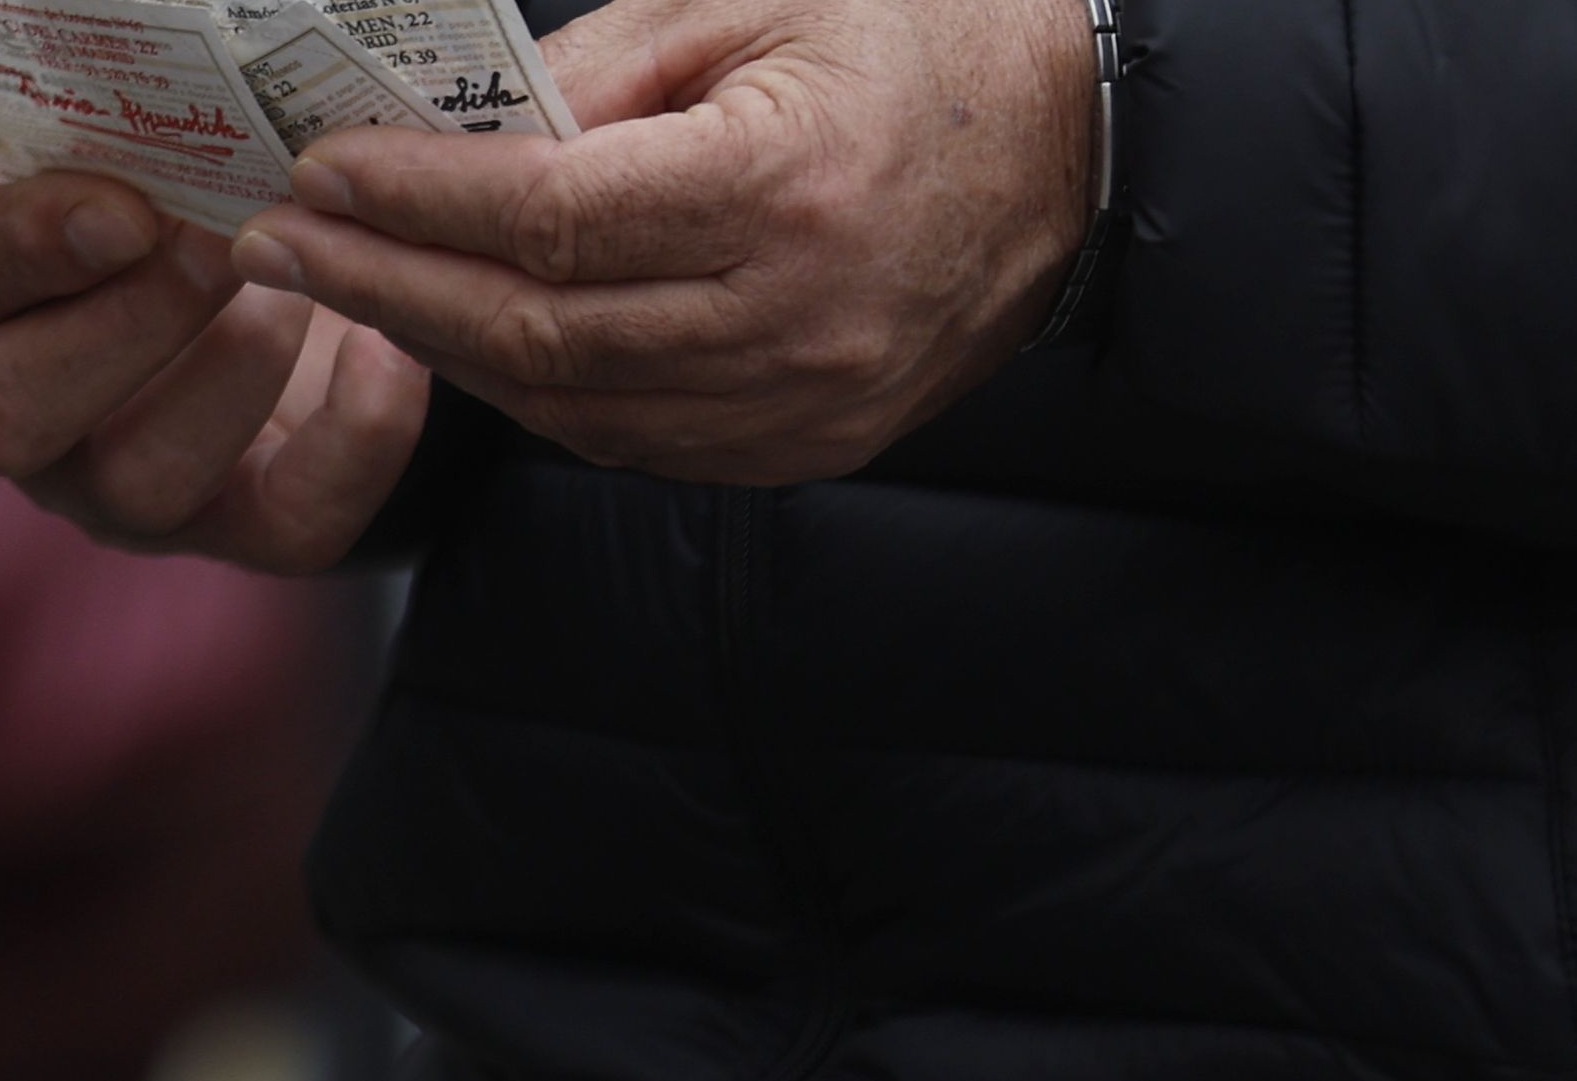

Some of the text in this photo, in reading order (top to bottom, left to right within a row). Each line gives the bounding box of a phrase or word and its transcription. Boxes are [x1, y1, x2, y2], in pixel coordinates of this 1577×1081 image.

[337, 11, 433, 36] MEN, 22
[356, 33, 398, 49] RID
[387, 49, 438, 68] 76 39
[273, 80, 298, 98] 22
